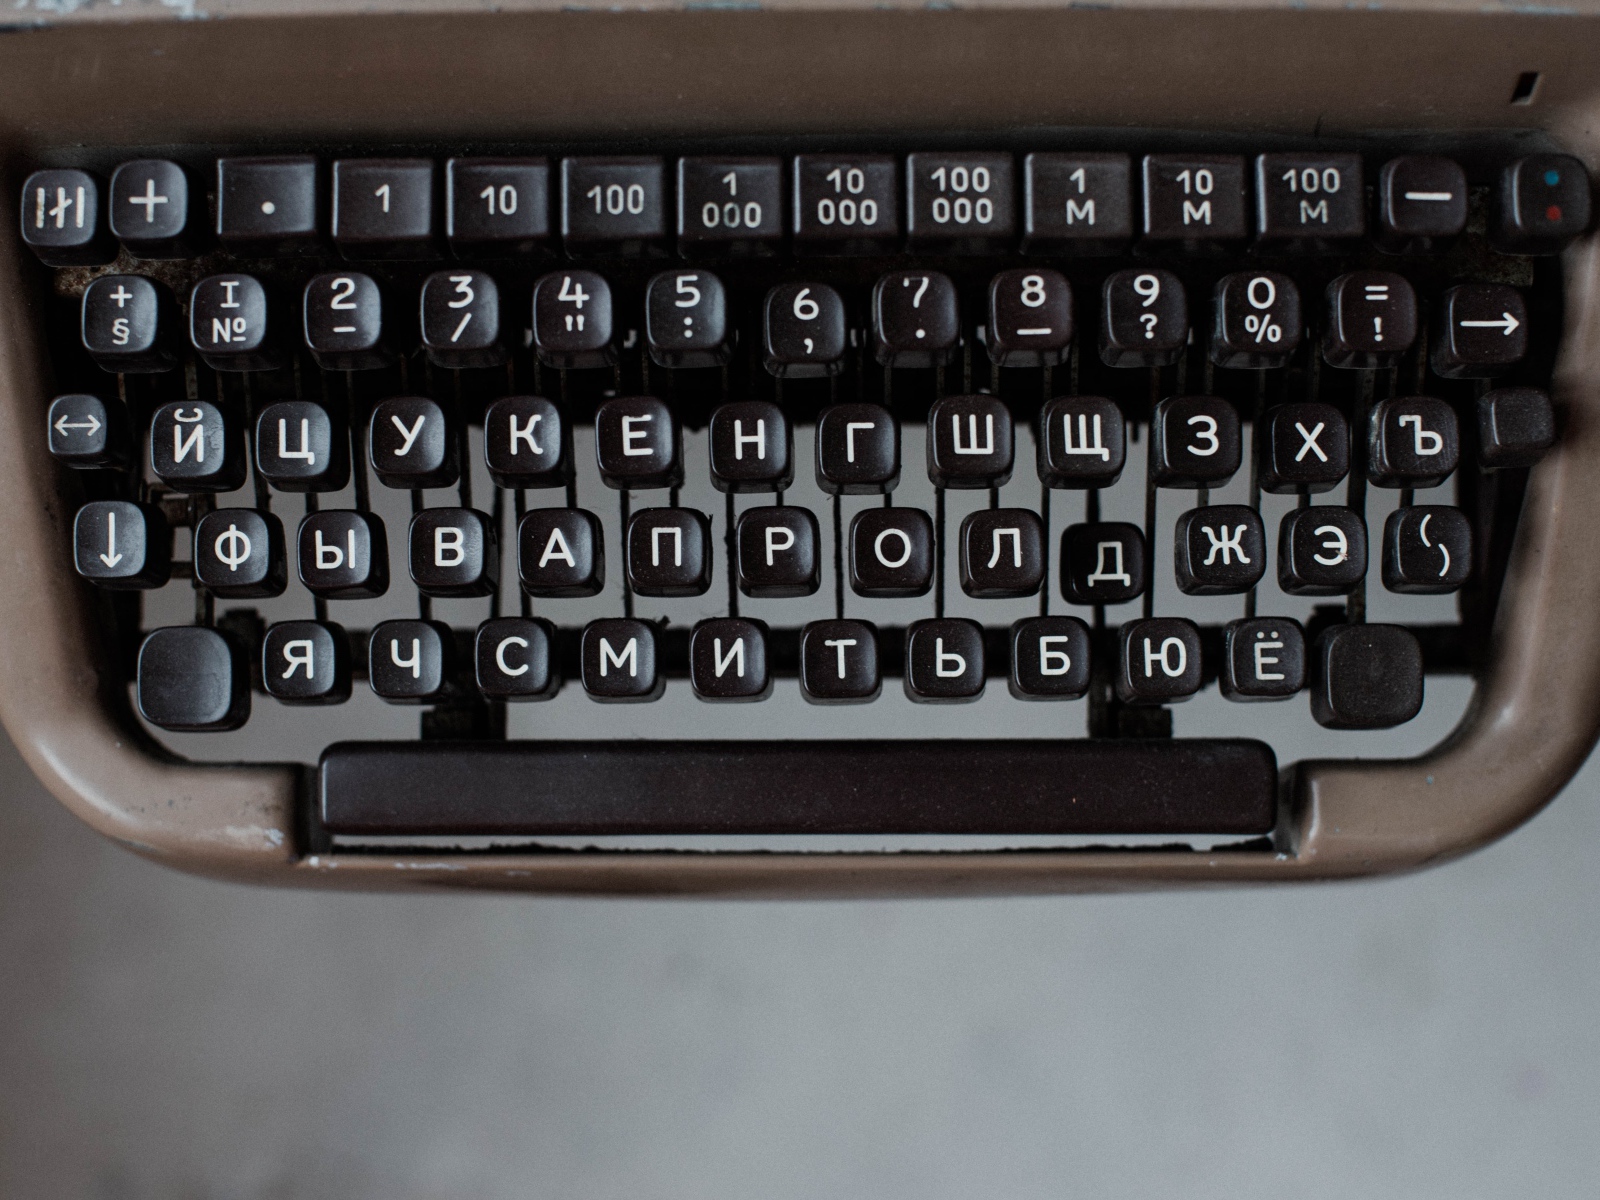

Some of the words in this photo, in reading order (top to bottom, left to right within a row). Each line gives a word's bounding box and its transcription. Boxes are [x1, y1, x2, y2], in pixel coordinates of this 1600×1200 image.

[375, 184, 390, 213] 1
[480, 185, 517, 215] 10
[587, 184, 645, 215] 100
[722, 172, 737, 196] 1
[826, 168, 865, 194] 10
[931, 166, 990, 193] 100
[1069, 167, 1085, 193] 1
[1175, 169, 1213, 195] 10
[1282, 168, 1341, 193] 100
[702, 202, 762, 228] 000
[818, 198, 878, 226] 000
[932, 197, 993, 224] 000
[330, 277, 358, 310] 2
[448, 275, 475, 309] 3
[557, 276, 590, 309] 4
[675, 274, 701, 308] 5
[793, 288, 820, 321] 6
[903, 276, 929, 308] 7
[1020, 275, 1046, 308] 8
[1133, 274, 1160, 307] 9
[1139, 313, 1158, 339] ?
[1244, 313, 1282, 343] %
[173, 407, 205, 464] Й
[278, 418, 316, 466] Ц
[391, 414, 426, 456] У
[509, 414, 544, 456] К
[621, 414, 654, 456] Е
[734, 418, 766, 460] Н
[846, 422, 875, 463] Г
[952, 413, 994, 455] Ш
[1063, 413, 1110, 462] Щ
[1187, 414, 1220, 456] З
[1295, 422, 1328, 463] Х
[1399, 414, 1443, 456] Ъ
[214, 523, 252, 572] Ф
[315, 528, 356, 570] Ы
[434, 526, 465, 567] В
[538, 527, 576, 568] А
[651, 526, 682, 567] П
[765, 526, 795, 566] Р
[874, 528, 912, 568] О
[987, 527, 1023, 569] Л
[1087, 541, 1131, 587] Д
[1201, 524, 1251, 566] Ж
[1313, 525, 1348, 566] Э
[282, 639, 314, 680] Я
[390, 638, 421, 679] Ч
[495, 636, 529, 677] С
[599, 637, 638, 677] М
[713, 637, 745, 678] И
[824, 638, 857, 679] Т
[935, 637, 967, 678] Ь
[1039, 635, 1071, 676] Б
[1143, 636, 1187, 678] Ю
[1254, 631, 1285, 681] Ё
